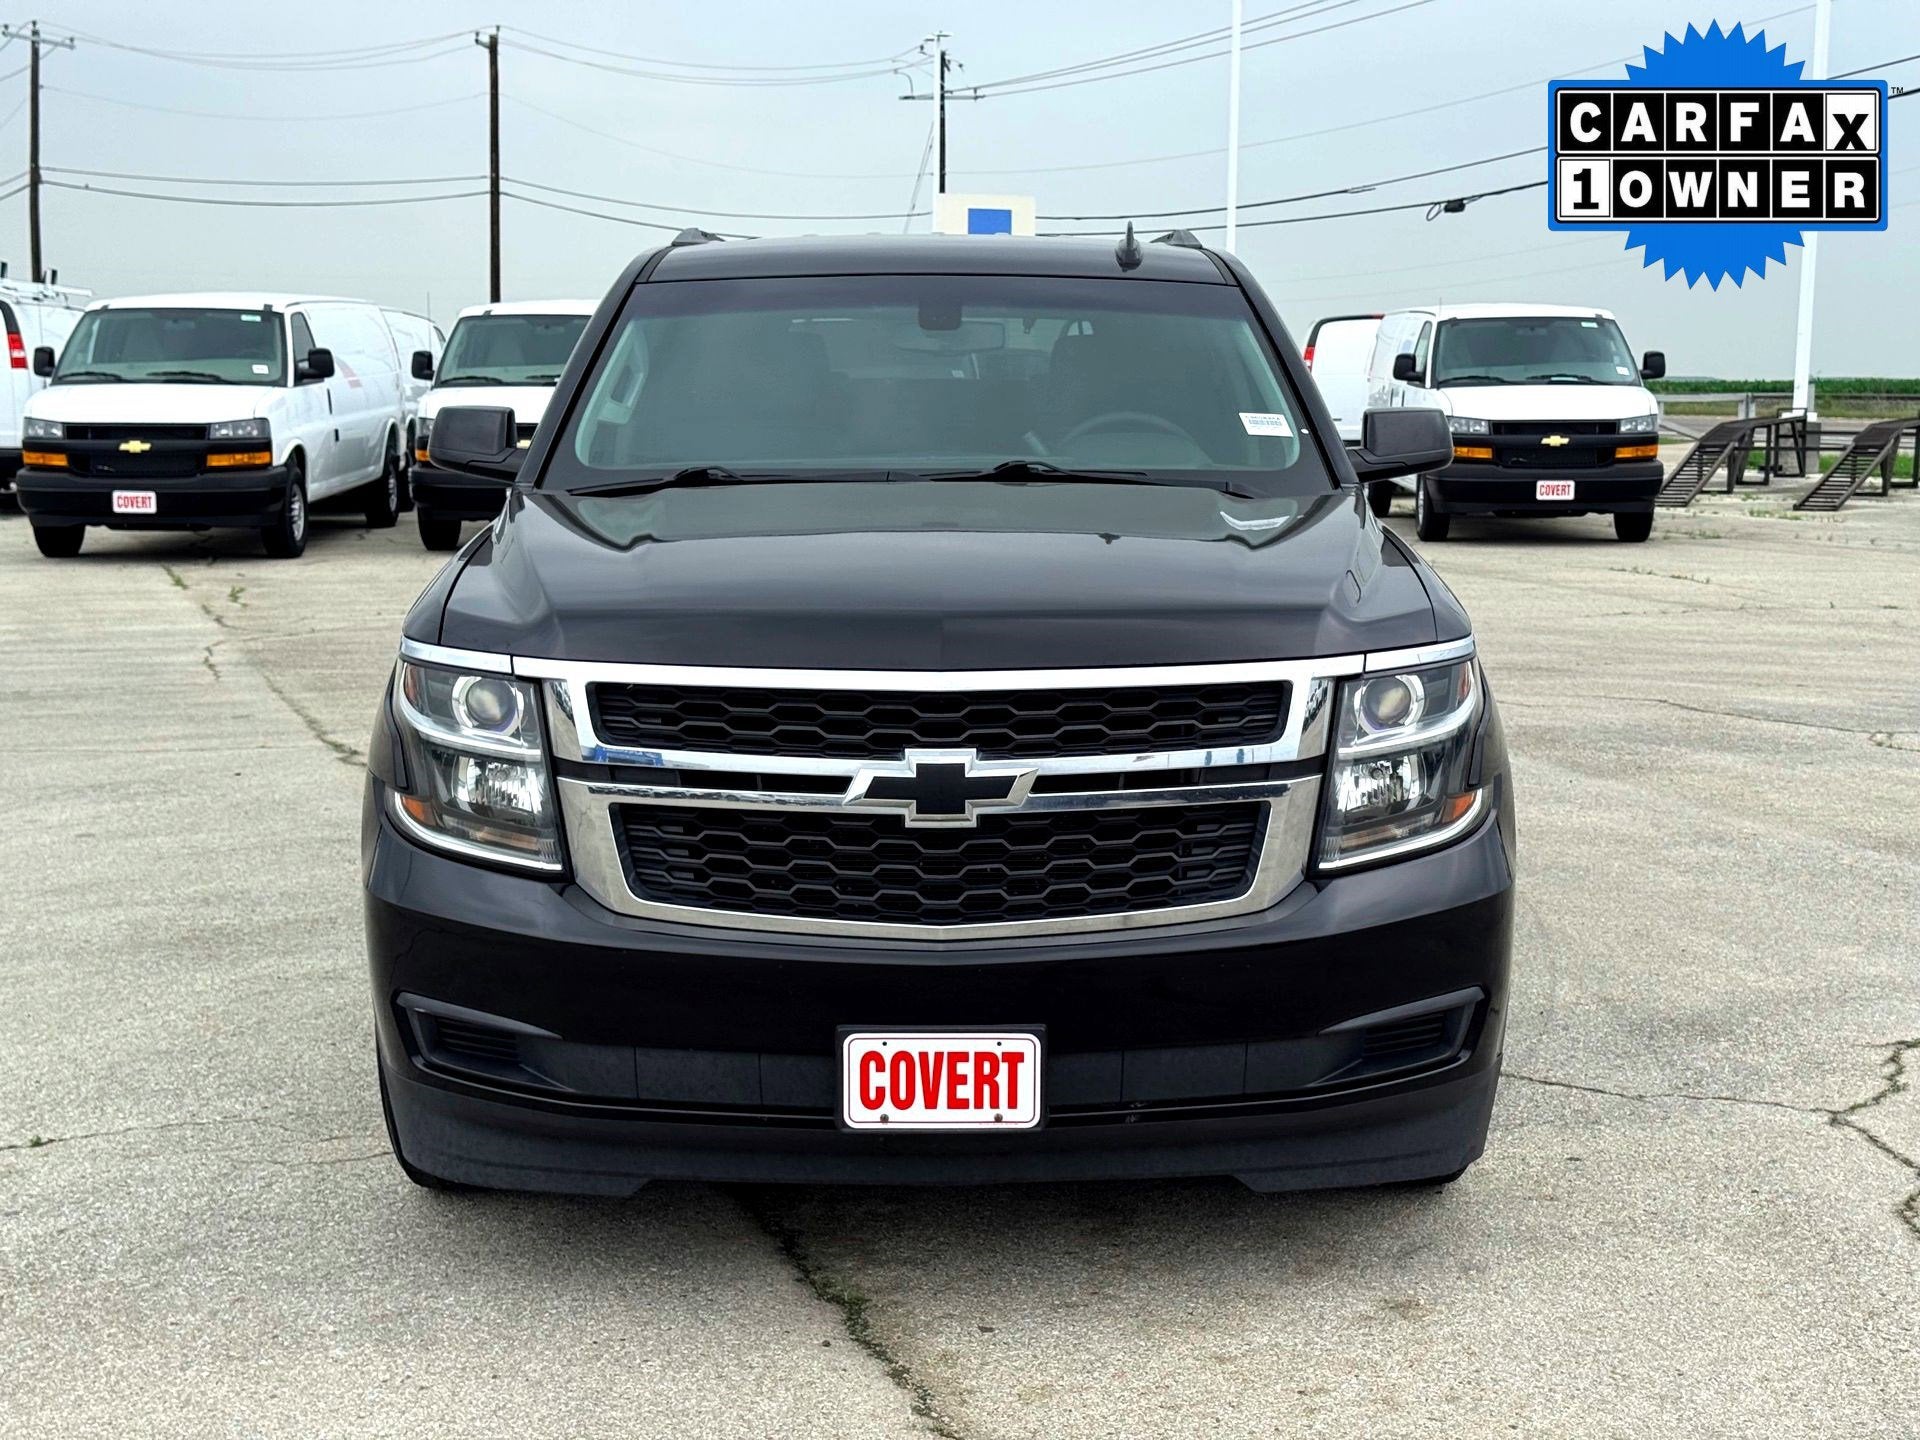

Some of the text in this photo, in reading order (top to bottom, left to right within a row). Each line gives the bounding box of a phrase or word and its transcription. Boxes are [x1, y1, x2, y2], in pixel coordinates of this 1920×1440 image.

[1539, 484, 1572, 497] COVERT
[116, 495, 153, 509] COVERT
[859, 1050, 1025, 1111] COVERT
